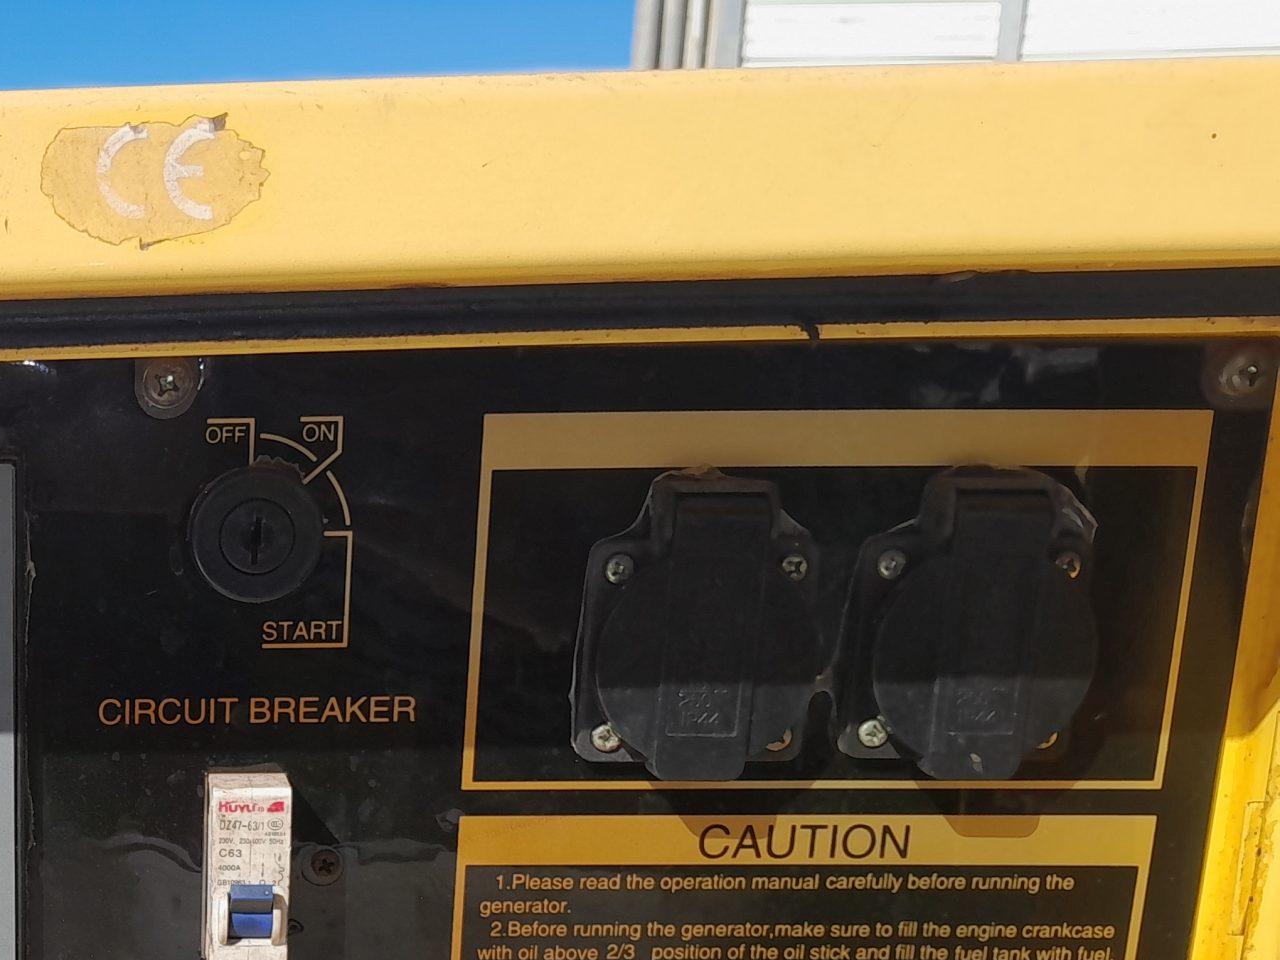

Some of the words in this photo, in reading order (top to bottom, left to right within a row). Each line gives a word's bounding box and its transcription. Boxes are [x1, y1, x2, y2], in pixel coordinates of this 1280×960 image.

[96, 118, 215, 220] CE
[205, 425, 246, 445] OFF
[302, 424, 334, 443] ON
[261, 620, 343, 642] START
[98, 697, 239, 726] CIRCUIT
[249, 695, 416, 724] BREAKER
[219, 819, 265, 831] DZ47-63/1
[697, 823, 911, 862] CAUTION
[218, 848, 242, 858] C63
[217, 864, 241, 872] 4000A
[496, 873, 574, 890] 1.Please
[579, 873, 621, 890] read
[626, 873, 655, 890] the
[660, 873, 746, 893] operation
[751, 873, 820, 890] manual
[825, 872, 904, 894] carefully
[907, 872, 967, 890] before
[971, 873, 1041, 894] running
[1045, 873, 1075, 891] the
[479, 898, 571, 918] generator.
[490, 920, 568, 937] 2.Before
[573, 920, 642, 941] running
[646, 920, 676, 937] the
[830, 923, 871, 937] sure
[875, 921, 893, 937] to
[897, 920, 918, 937] fill
[922, 920, 951, 937] the
[955, 920, 1018, 942] engine
[1021, 921, 1115, 938] crankcase
[477, 944, 513, 960] with
[517, 944, 538, 960] oil
[543, 944, 599, 960] above
[606, 943, 636, 960] 2/3
[727, 943, 746, 960] of
[750, 943, 779, 960] the
[783, 943, 806, 960] oil
[809, 943, 851, 960] stick
[855, 943, 891, 960] and
[895, 943, 916, 960] fill
[919, 943, 949, 960] the
